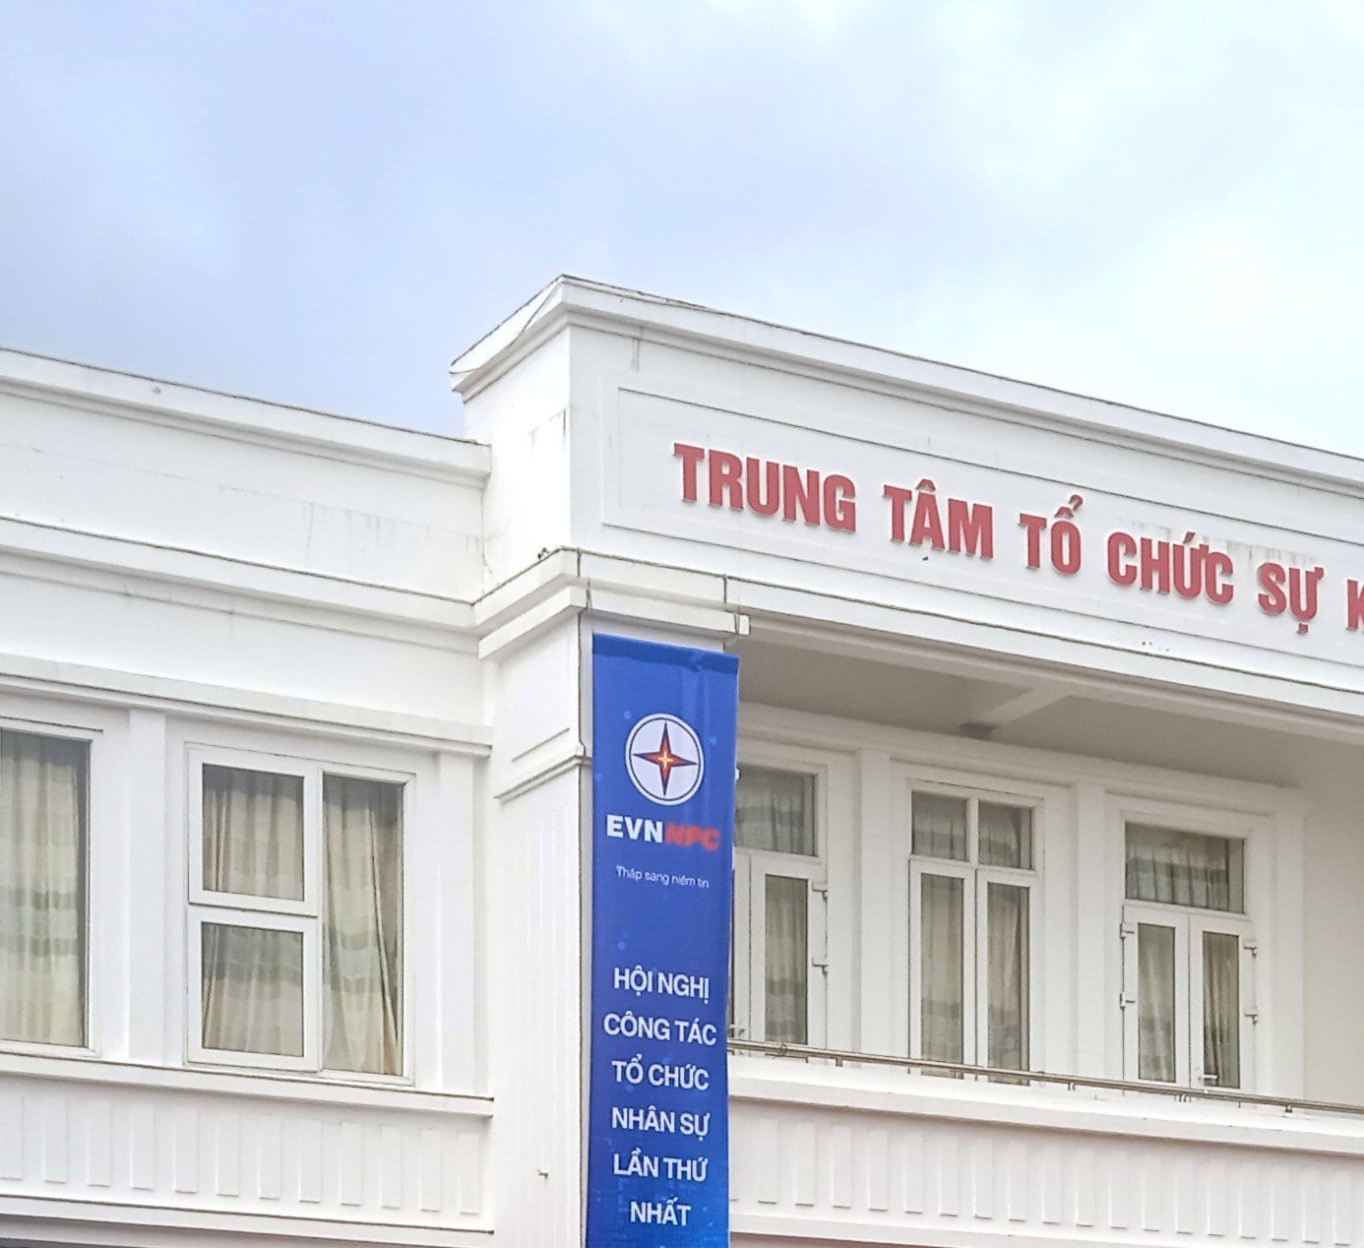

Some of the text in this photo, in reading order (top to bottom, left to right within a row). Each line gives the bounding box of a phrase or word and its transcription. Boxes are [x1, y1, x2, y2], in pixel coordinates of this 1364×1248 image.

[675, 444, 857, 532] TRUNG
[885, 480, 994, 558] TÂM
[1020, 495, 1082, 575] TỔ
[1107, 532, 1234, 604] CHỨC
[1259, 563, 1324, 632] SỰ
[614, 965, 709, 1004] HỘI NGHỊ
[604, 1011, 716, 1045] CÔNG TÁC
[612, 1054, 708, 1090] TỔ CHỨC
[612, 1105, 710, 1141] NHÂN SỰ
[614, 1148, 708, 1181] LẦN THỨ
[631, 1197, 691, 1225] NHẤT
